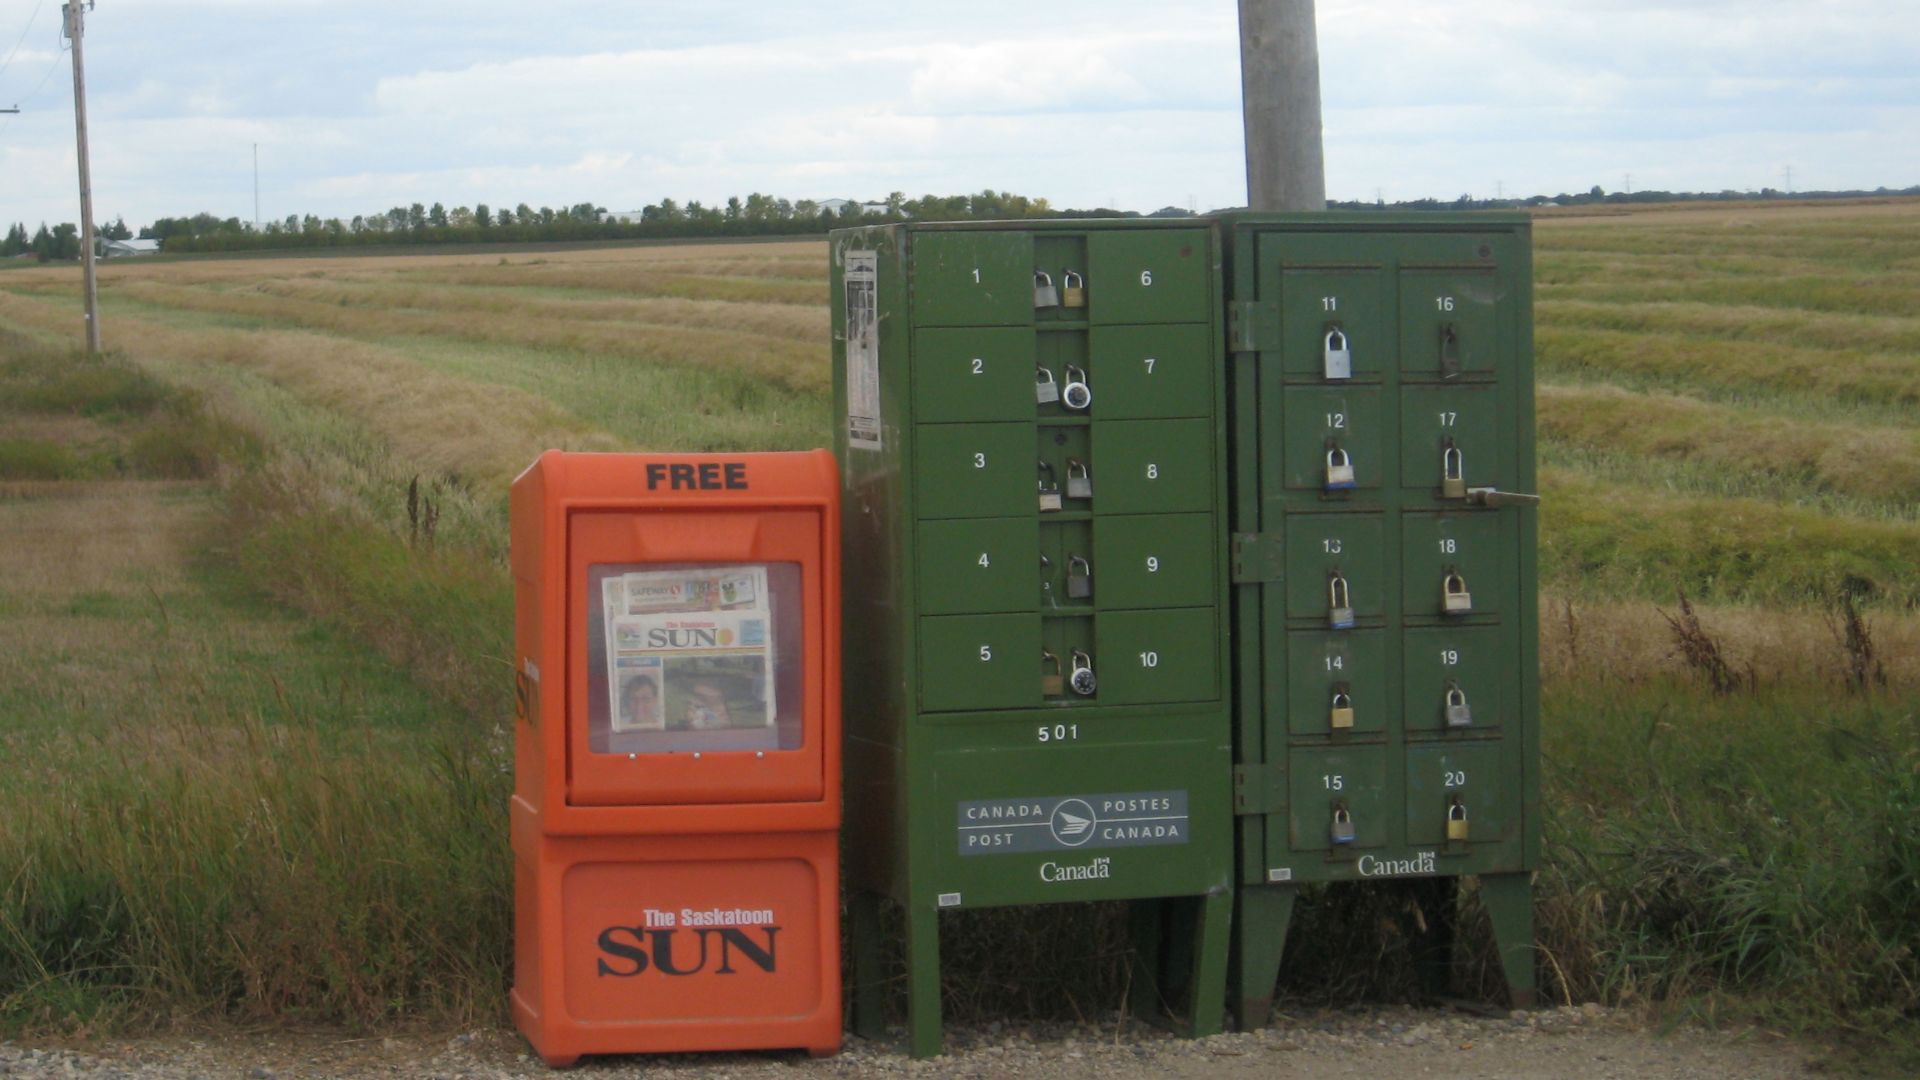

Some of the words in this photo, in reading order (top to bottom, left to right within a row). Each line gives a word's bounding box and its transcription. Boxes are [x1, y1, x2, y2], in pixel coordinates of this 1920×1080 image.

[972, 268, 980, 284] 1
[1140, 270, 1152, 286] 6
[1322, 296, 1336, 311] 11
[1436, 296, 1454, 312] 16
[972, 358, 983, 374] 2
[1144, 358, 1155, 374] 7
[1327, 413, 1344, 429] 12
[1439, 412, 1457, 427] 17
[974, 452, 986, 468] 3
[646, 463, 748, 490] FREE
[1146, 463, 1158, 479] 8
[1323, 539, 1341, 554] 13
[1439, 538, 1456, 554] 18
[978, 552, 990, 568] 4
[1146, 556, 1158, 572] 9
[647, 628, 718, 648] SUN
[980, 645, 992, 661] 5
[1139, 651, 1158, 667] 10
[1440, 650, 1458, 665] 19
[1325, 655, 1343, 671] 14
[1038, 724, 1077, 742] 501
[1323, 774, 1343, 791] 15
[1444, 770, 1465, 787] 20
[967, 804, 1043, 820] CANADA
[1103, 798, 1170, 813] POSTES
[968, 833, 1013, 847] POST
[1103, 825, 1179, 840] CANADA
[1039, 857, 1110, 882] Canada
[1357, 852, 1435, 876] Canada
[643, 909, 675, 927] The
[681, 908, 773, 926] Saskatoon
[597, 926, 782, 977] SUN
